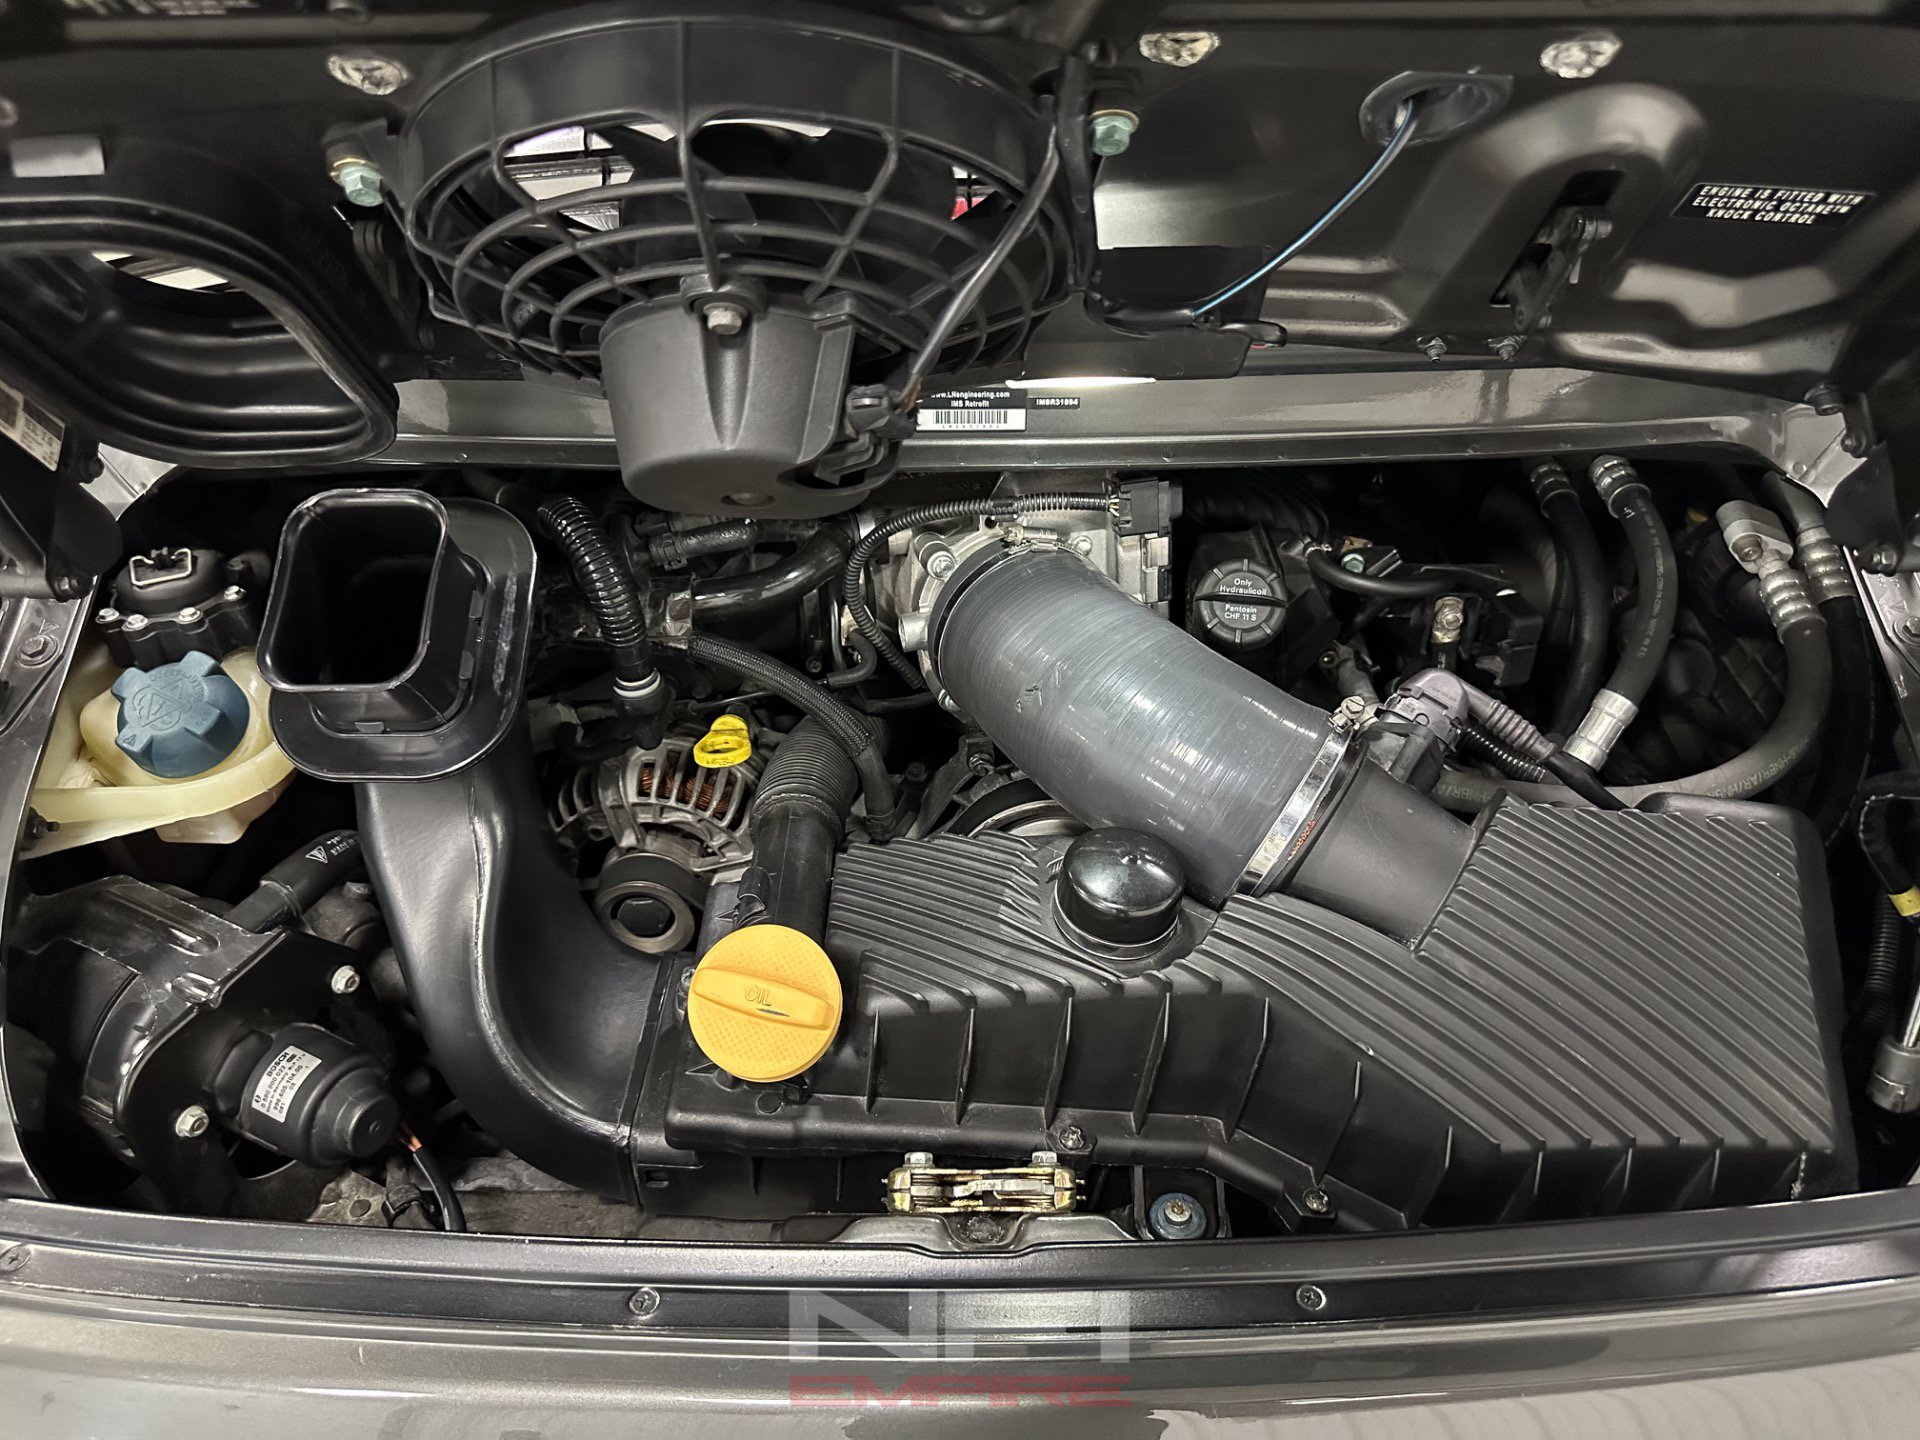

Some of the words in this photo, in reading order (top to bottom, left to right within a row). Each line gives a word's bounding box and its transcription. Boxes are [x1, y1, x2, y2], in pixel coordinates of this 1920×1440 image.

[1700, 185, 1752, 199] ENGINE
[1754, 188, 1773, 200] IS
[1773, 189, 1824, 203] FITTED
[1827, 193, 1865, 205] WITH
[1692, 197, 1779, 211] ELECTRONIC
[1705, 208, 1752, 221] KNOCK
[1754, 212, 1817, 225] CONTROL
[1234, 577, 1252, 588] Only
[1220, 585, 1267, 596] Hydraulicoil
[1224, 612, 1240, 620] CHF
[745, 985, 772, 1006] OIL
[266, 1052, 290, 1077] BOSCH
